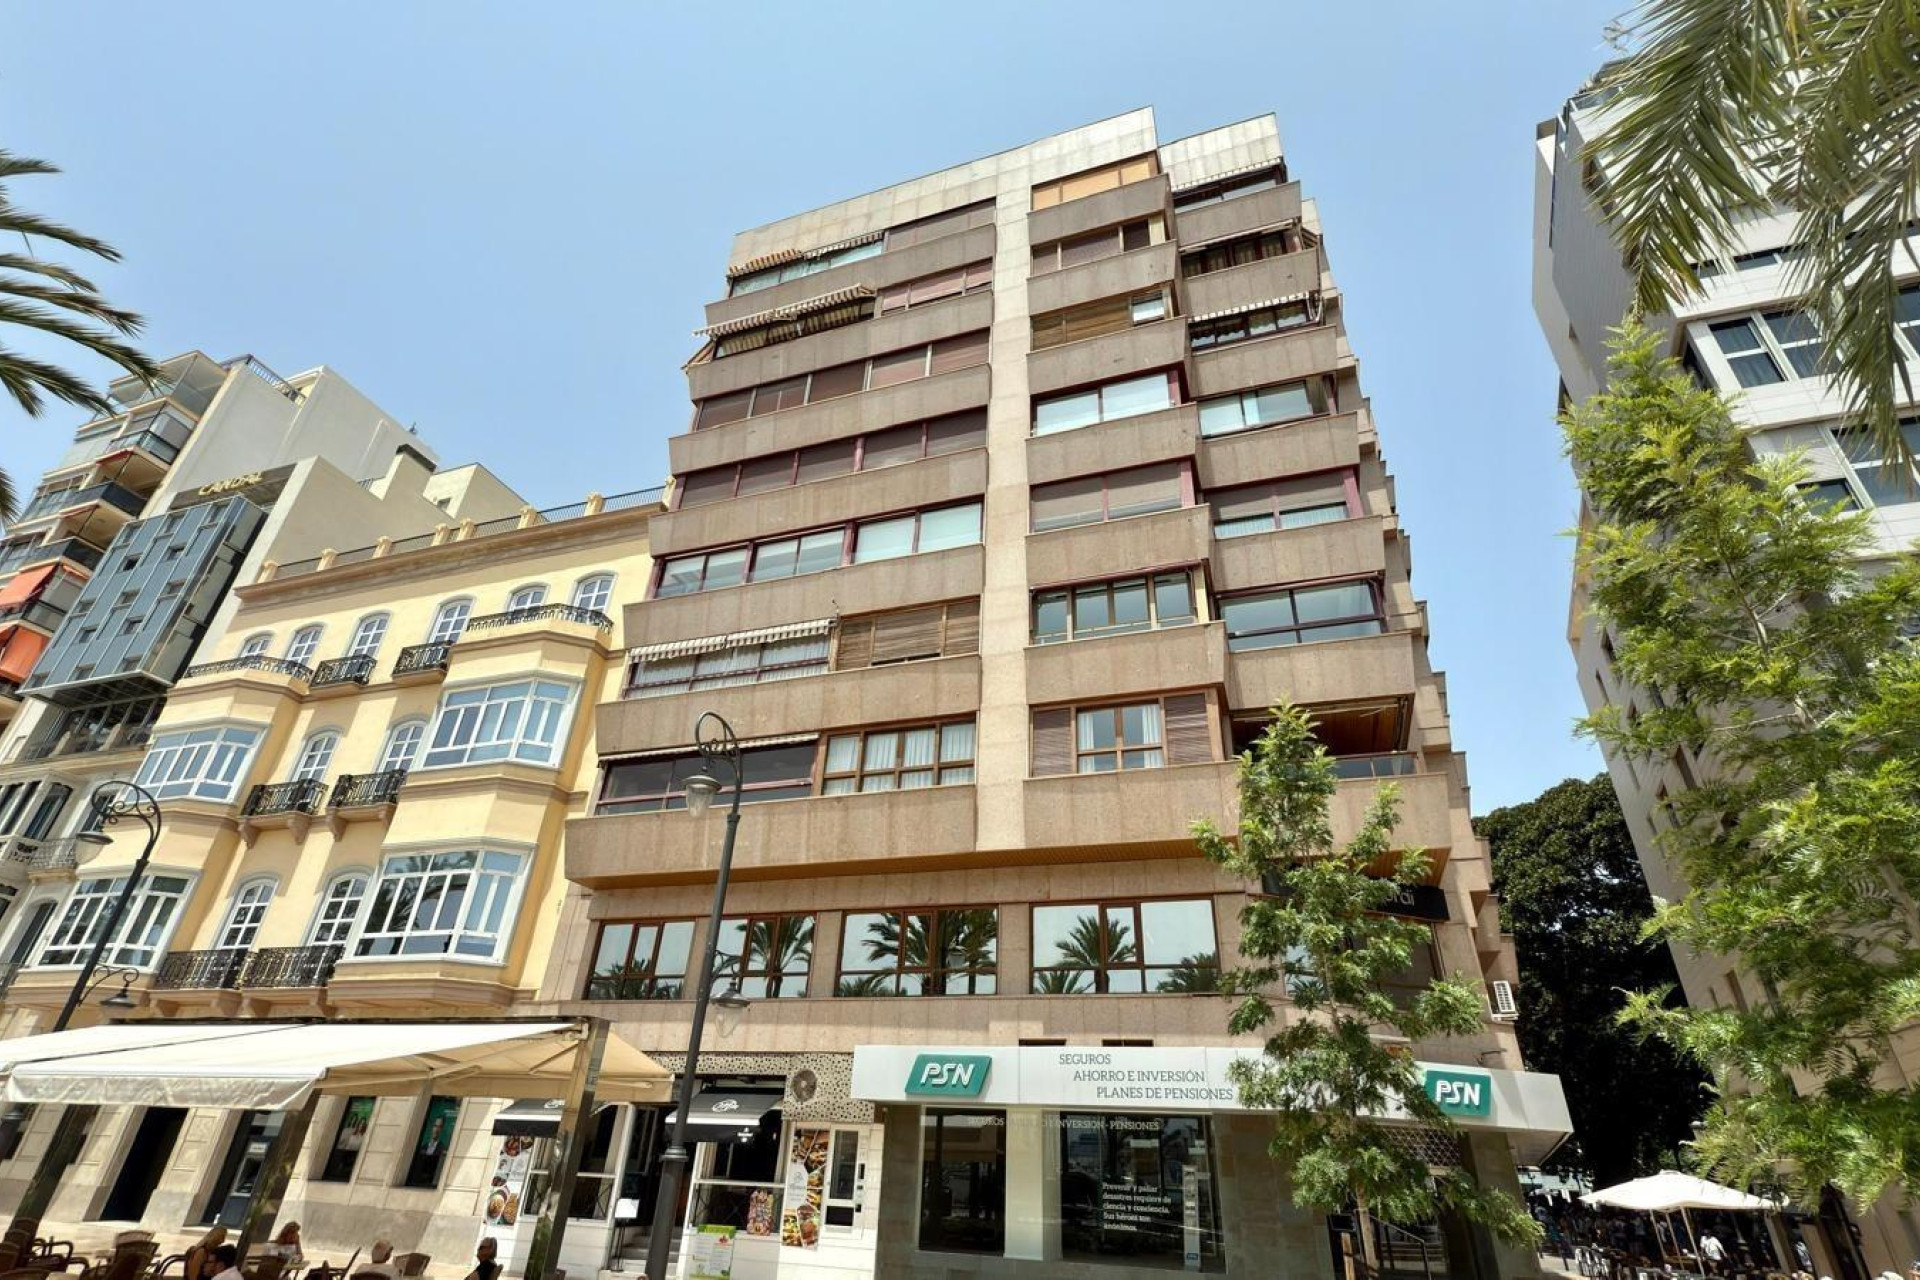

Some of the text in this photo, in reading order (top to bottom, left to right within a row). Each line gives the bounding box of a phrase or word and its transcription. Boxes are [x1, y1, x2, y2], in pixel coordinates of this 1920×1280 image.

[1059, 1053, 1112, 1065] SEGUROS
[920, 1063, 976, 1086] PSN
[1073, 1069, 1205, 1082] AHORRO E INVERSIÓN
[1097, 1086, 1233, 1100] PLANES DE PENSIONES
[1436, 1080, 1481, 1106] PSN
[1110, 1121, 1159, 1130] PENSIONES
